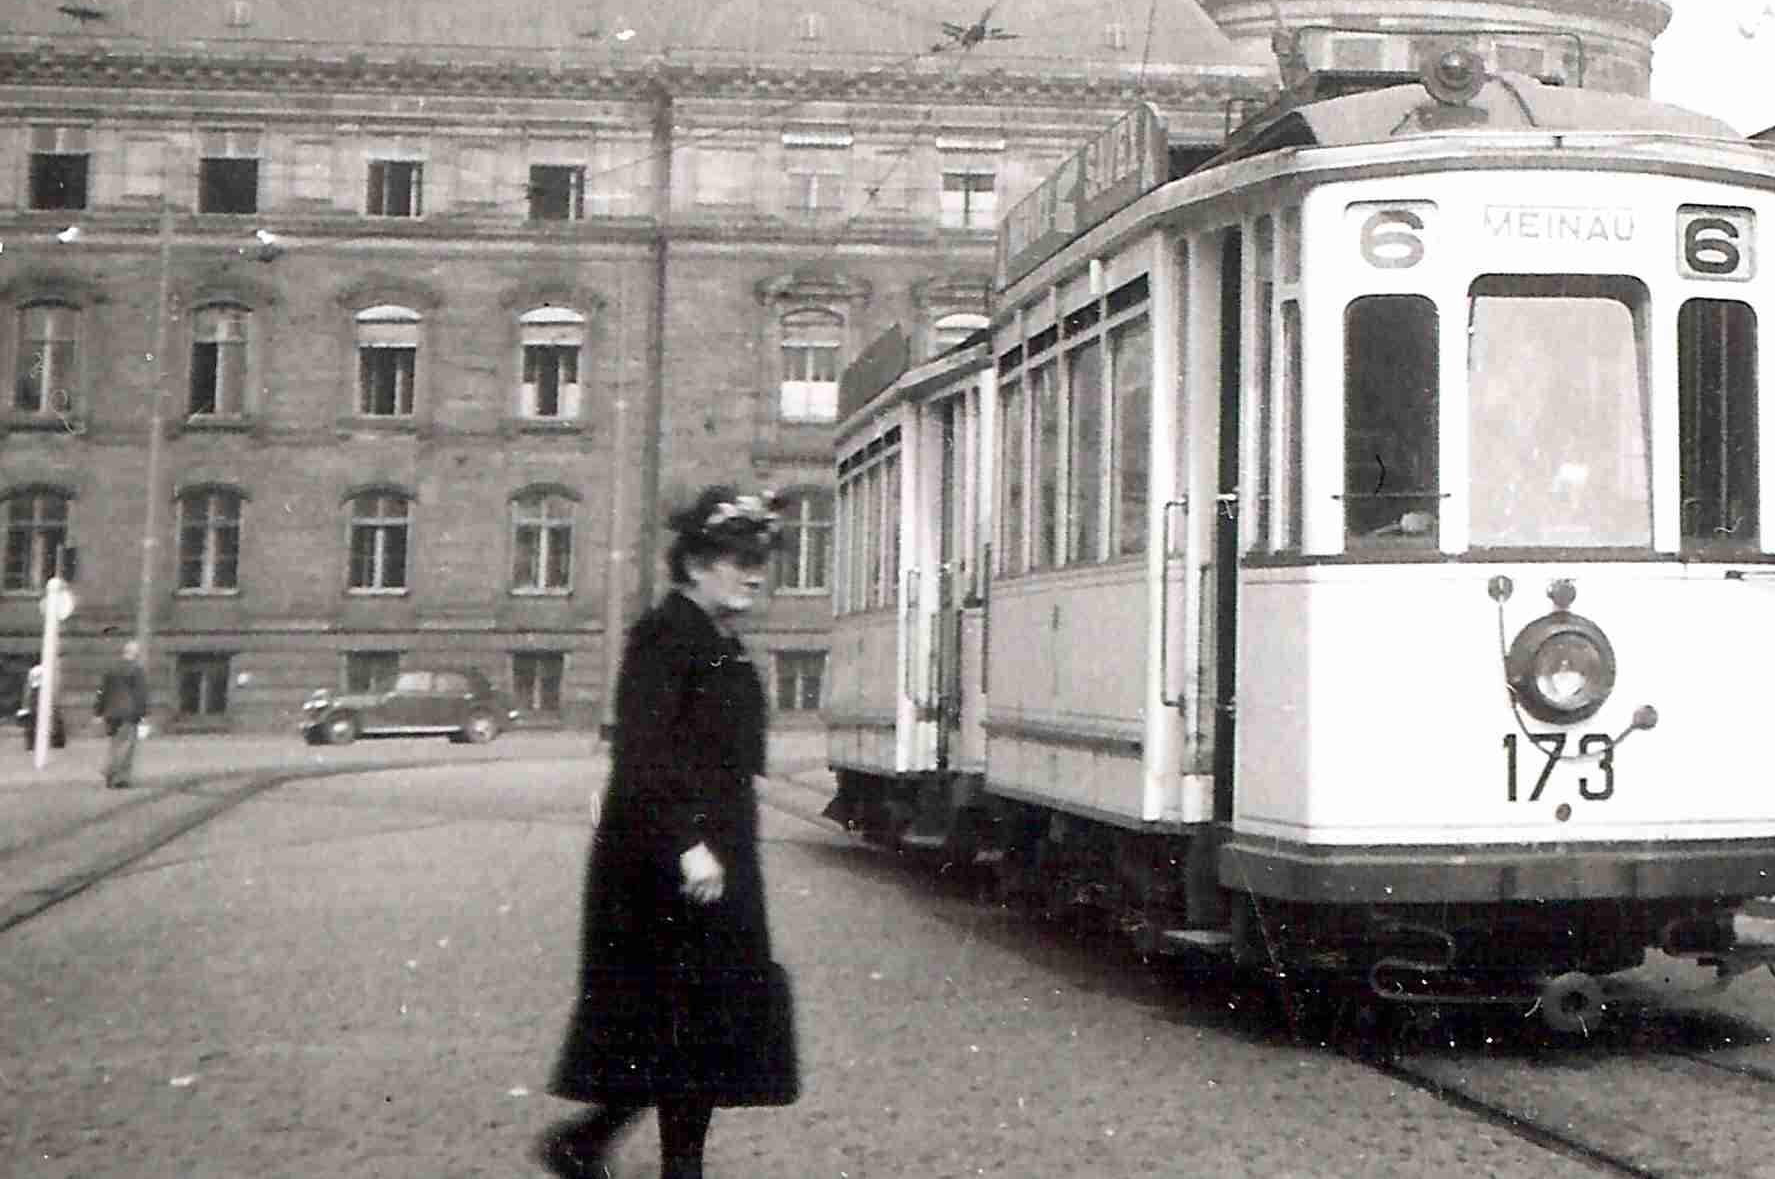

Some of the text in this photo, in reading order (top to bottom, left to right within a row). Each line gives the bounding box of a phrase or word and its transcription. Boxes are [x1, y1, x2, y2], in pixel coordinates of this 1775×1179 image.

[1360, 210, 1425, 269] 6
[1483, 210, 1636, 242] MEINAU
[1684, 217, 1741, 274] 6
[1502, 732, 1615, 802] 173
